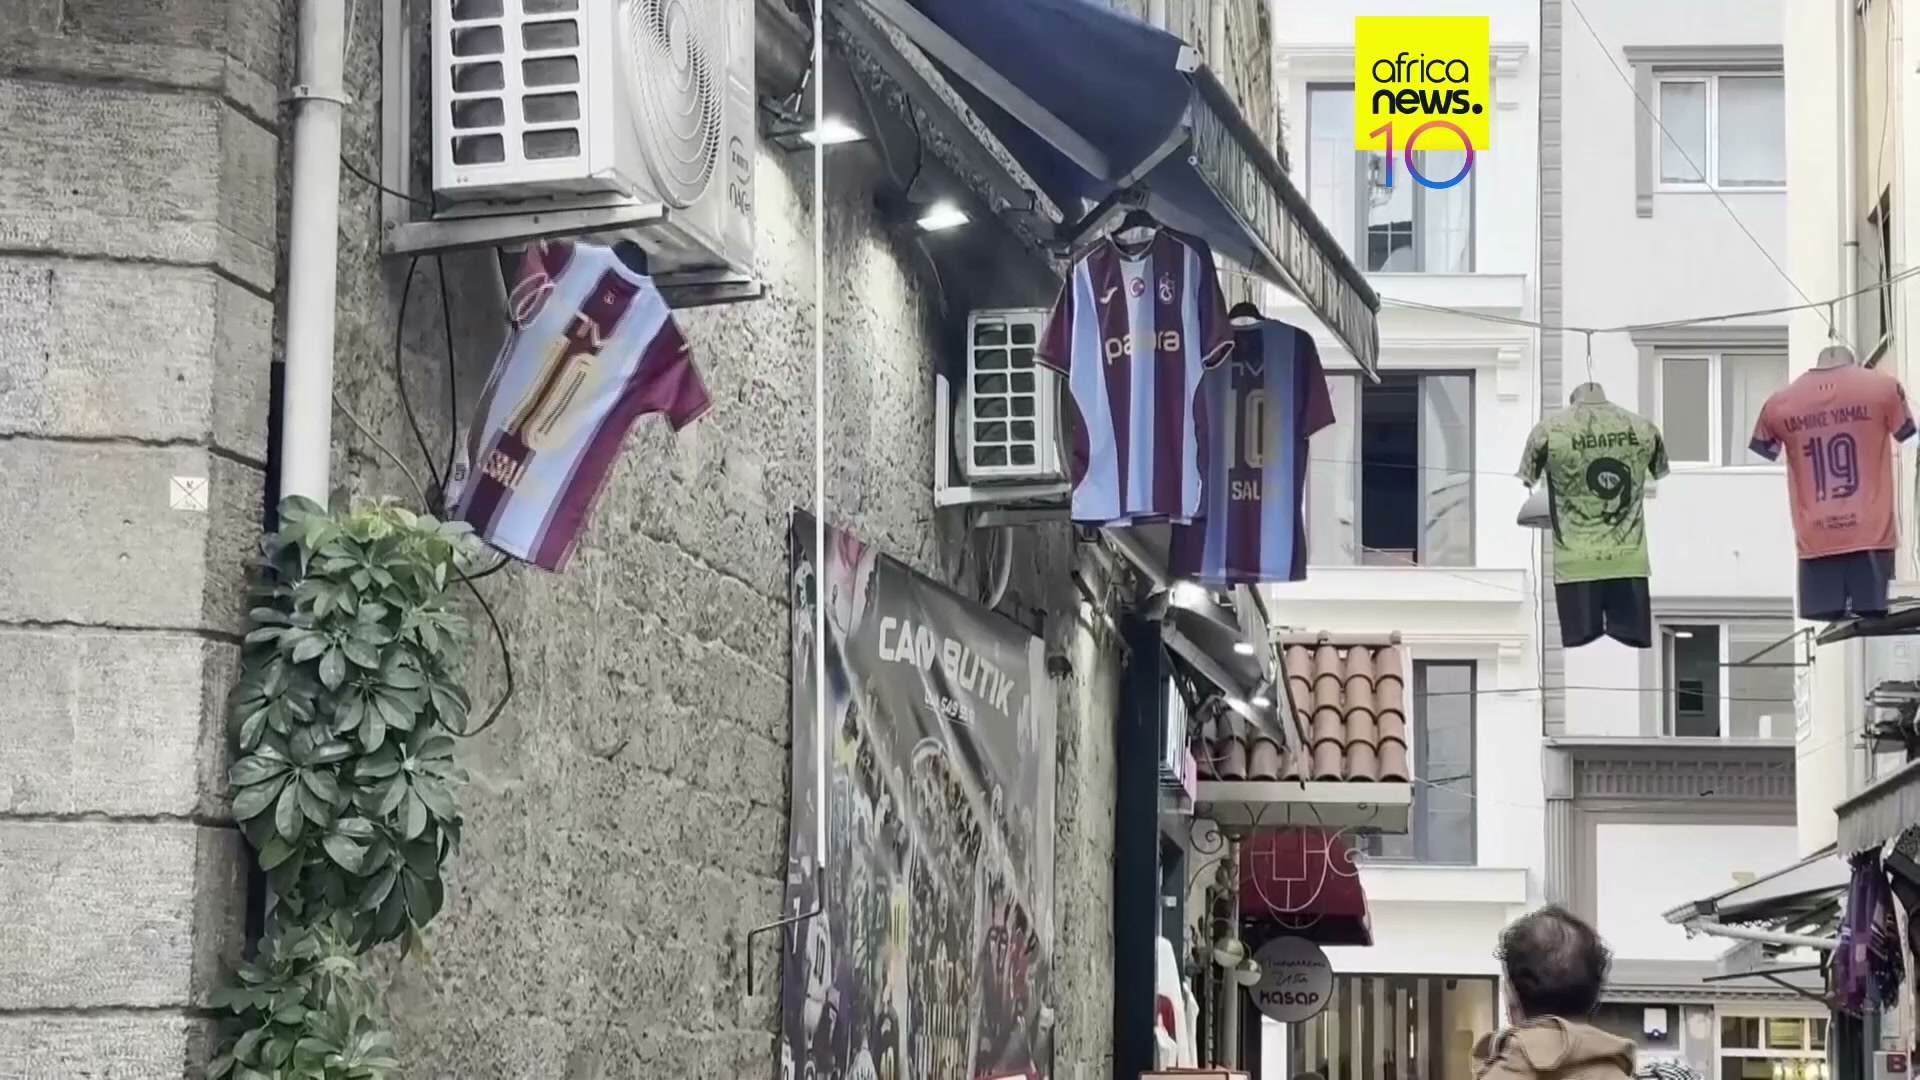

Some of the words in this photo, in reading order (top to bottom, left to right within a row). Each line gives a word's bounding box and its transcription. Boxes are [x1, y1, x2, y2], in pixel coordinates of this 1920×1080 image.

[1105, 330, 1180, 365] para
[1831, 405, 1871, 424] YAMAL
[1586, 457, 1631, 526] 9
[1803, 432, 1858, 502] 19
[879, 616, 936, 671] CAN
[943, 637, 1014, 717] BUTIK
